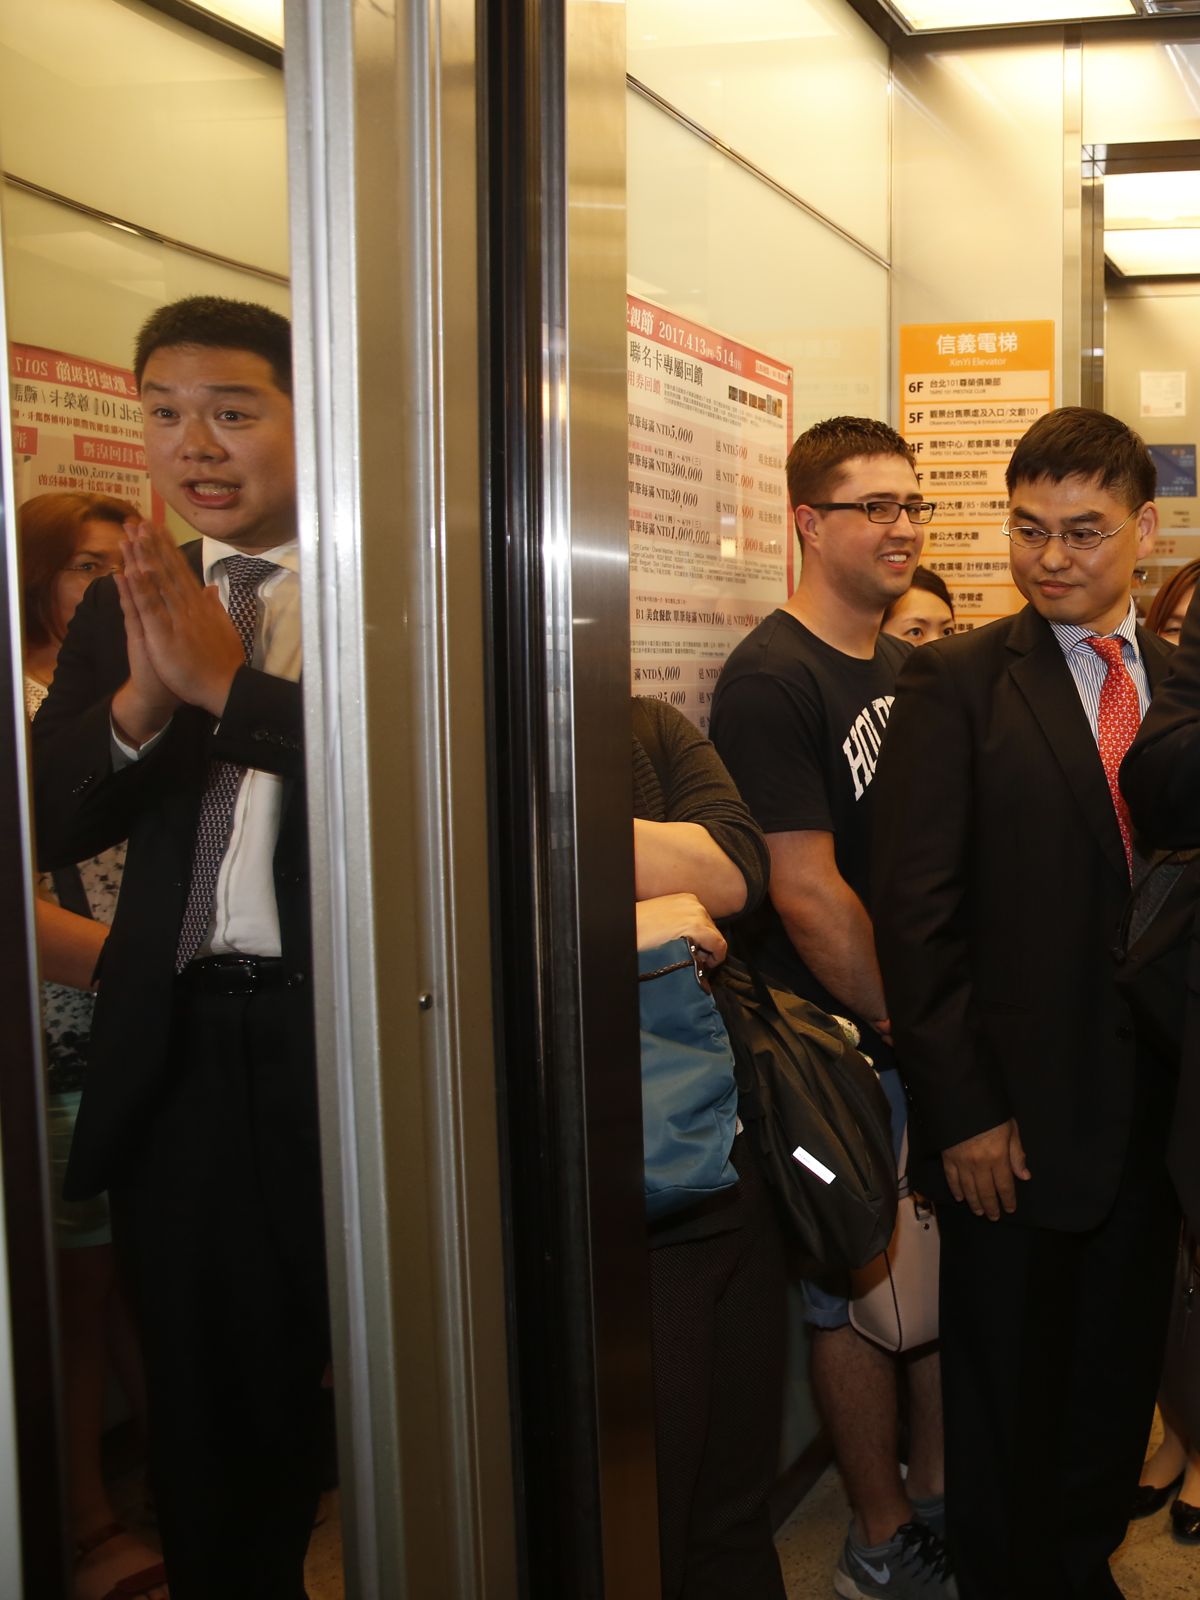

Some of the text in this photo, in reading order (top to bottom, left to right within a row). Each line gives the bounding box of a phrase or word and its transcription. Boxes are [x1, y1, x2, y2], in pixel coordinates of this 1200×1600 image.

[936, 332, 1018, 355] 信義電梯
[630, 340, 704, 388] 聯名卡專屬回饋
[972, 357, 1007, 366] Elevator
[908, 381, 924, 393] 6F
[908, 412, 924, 424] 5F
[656, 423, 694, 445] NTD5,000
[930, 470, 988, 480] 臺灣證券交易所
[929, 531, 980, 541] 辦公大樓大廳
[635, 608, 644, 619] B1
